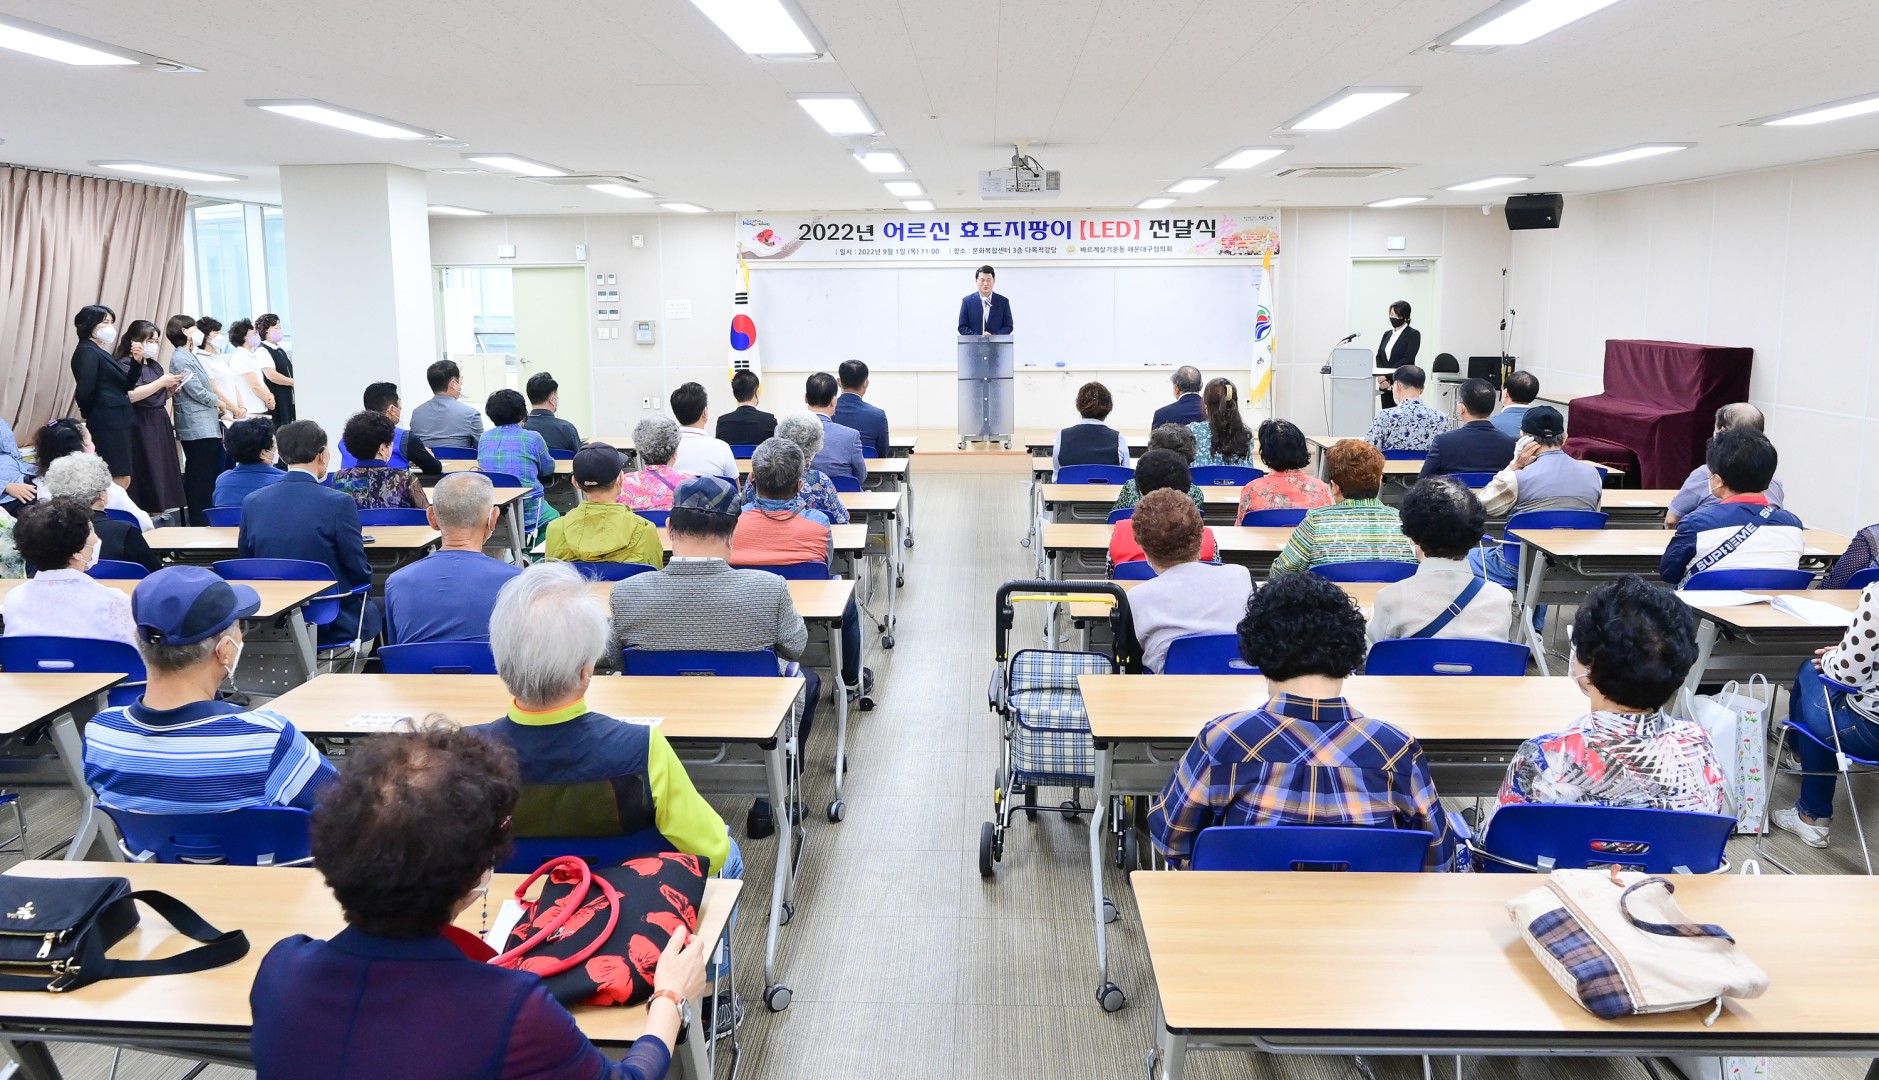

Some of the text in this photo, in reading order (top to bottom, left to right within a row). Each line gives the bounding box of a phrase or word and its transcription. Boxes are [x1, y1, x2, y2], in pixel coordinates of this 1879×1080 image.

[799, 222, 874, 241] 2022년
[884, 222, 949, 241] 어르신
[960, 221, 1071, 240] 효도지팡이
[1149, 219, 1215, 238] 전달식
[840, 248, 853, 256] 일시
[858, 248, 881, 256] 2022년
[883, 247, 894, 256] 9월
[896, 248, 906, 256] 1일
[908, 247, 920, 256] (목)
[954, 247, 967, 255] 장소
[973, 246, 1011, 255] 문화복합센터
[1013, 246, 1024, 255] 3층
[1025, 246, 1057, 254] 다목적강당
[1080, 245, 1173, 254] 바르게살기운동 해운대구협의회
